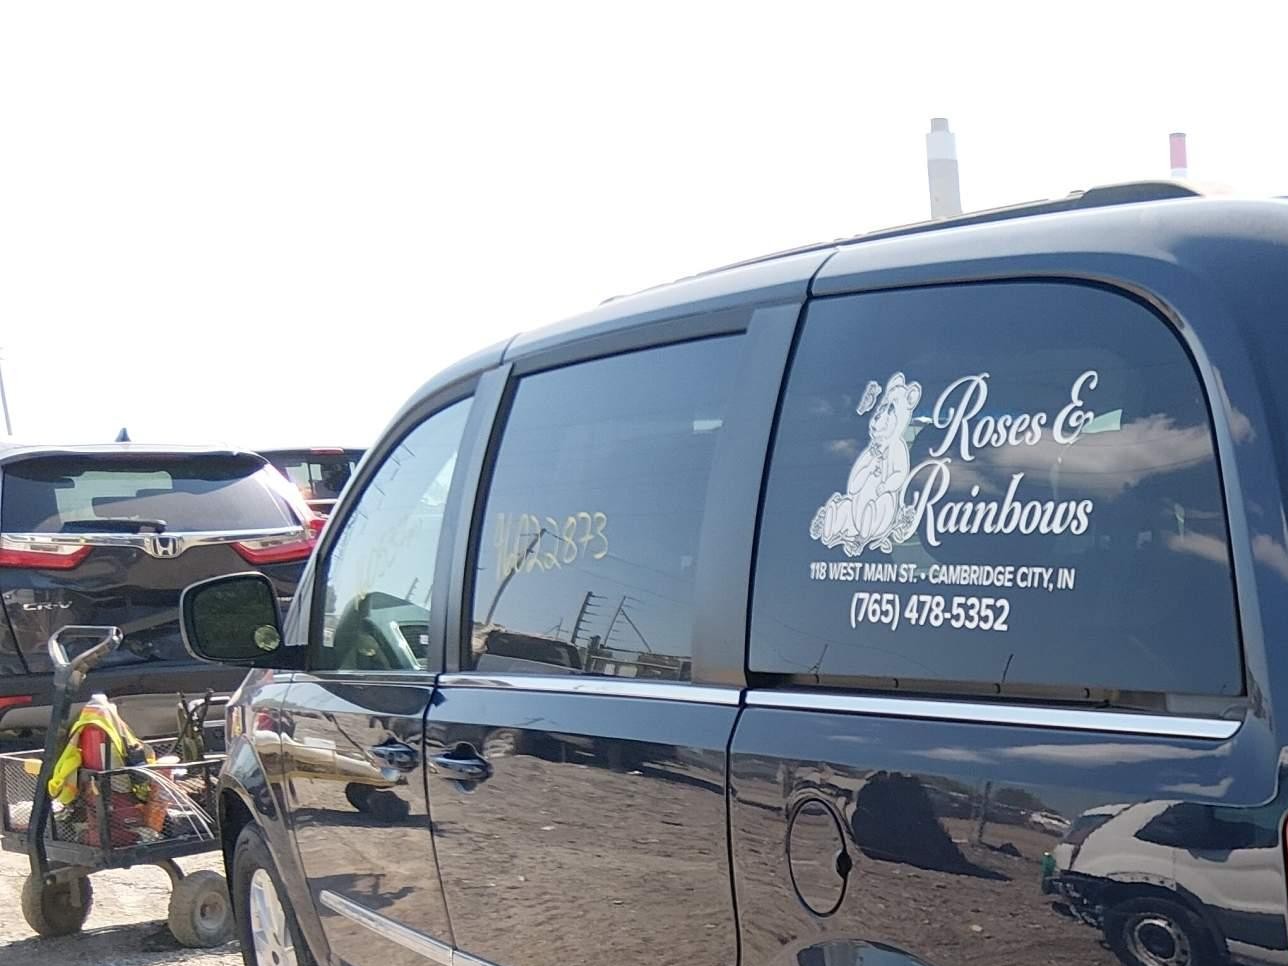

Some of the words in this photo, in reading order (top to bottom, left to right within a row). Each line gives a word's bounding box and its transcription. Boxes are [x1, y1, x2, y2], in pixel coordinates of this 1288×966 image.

[929, 372, 1047, 462] Roses
[1053, 370, 1099, 445] &
[902, 457, 1094, 547] Rainbows
[809, 561, 828, 581] 118
[829, 562, 863, 582] WEST
[863, 562, 898, 583] MAIN
[898, 563, 918, 584] ST.
[928, 564, 1015, 588] CAMBRIDGE
[1016, 566, 1054, 593] CITY,
[1056, 567, 1076, 590] IN
[850, 591, 901, 632] (765)
[903, 594, 1011, 632] 478-5352
